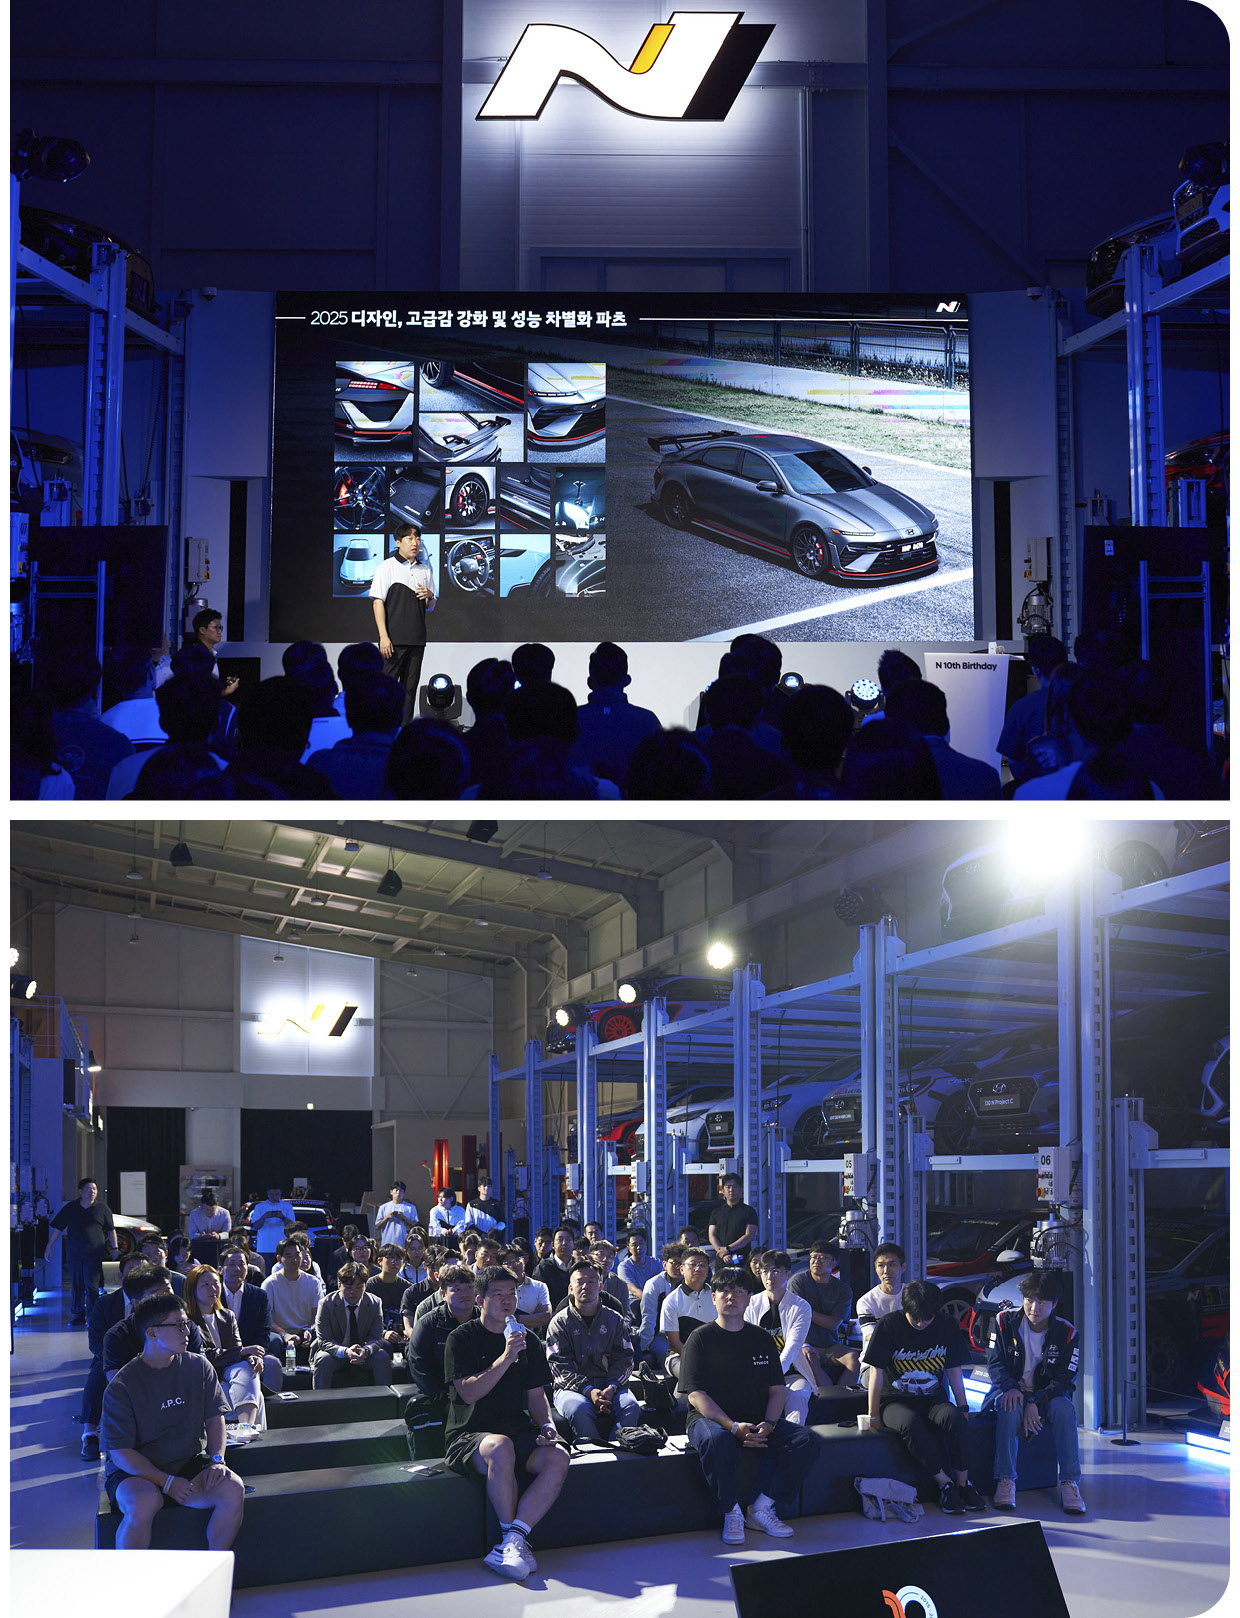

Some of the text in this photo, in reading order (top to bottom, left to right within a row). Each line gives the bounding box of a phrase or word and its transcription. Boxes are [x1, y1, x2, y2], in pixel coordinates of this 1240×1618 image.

[475, 11, 776, 122] N
[310, 310, 627, 328] 2025 디자인, 고급감 강화 및 성능 차별화 파츠
[962, 662, 997, 671] Birthday
[845, 1159, 852, 1168] 05
[1040, 1155, 1051, 1165] 06
[161, 1397, 185, 1410] A.P.C.
